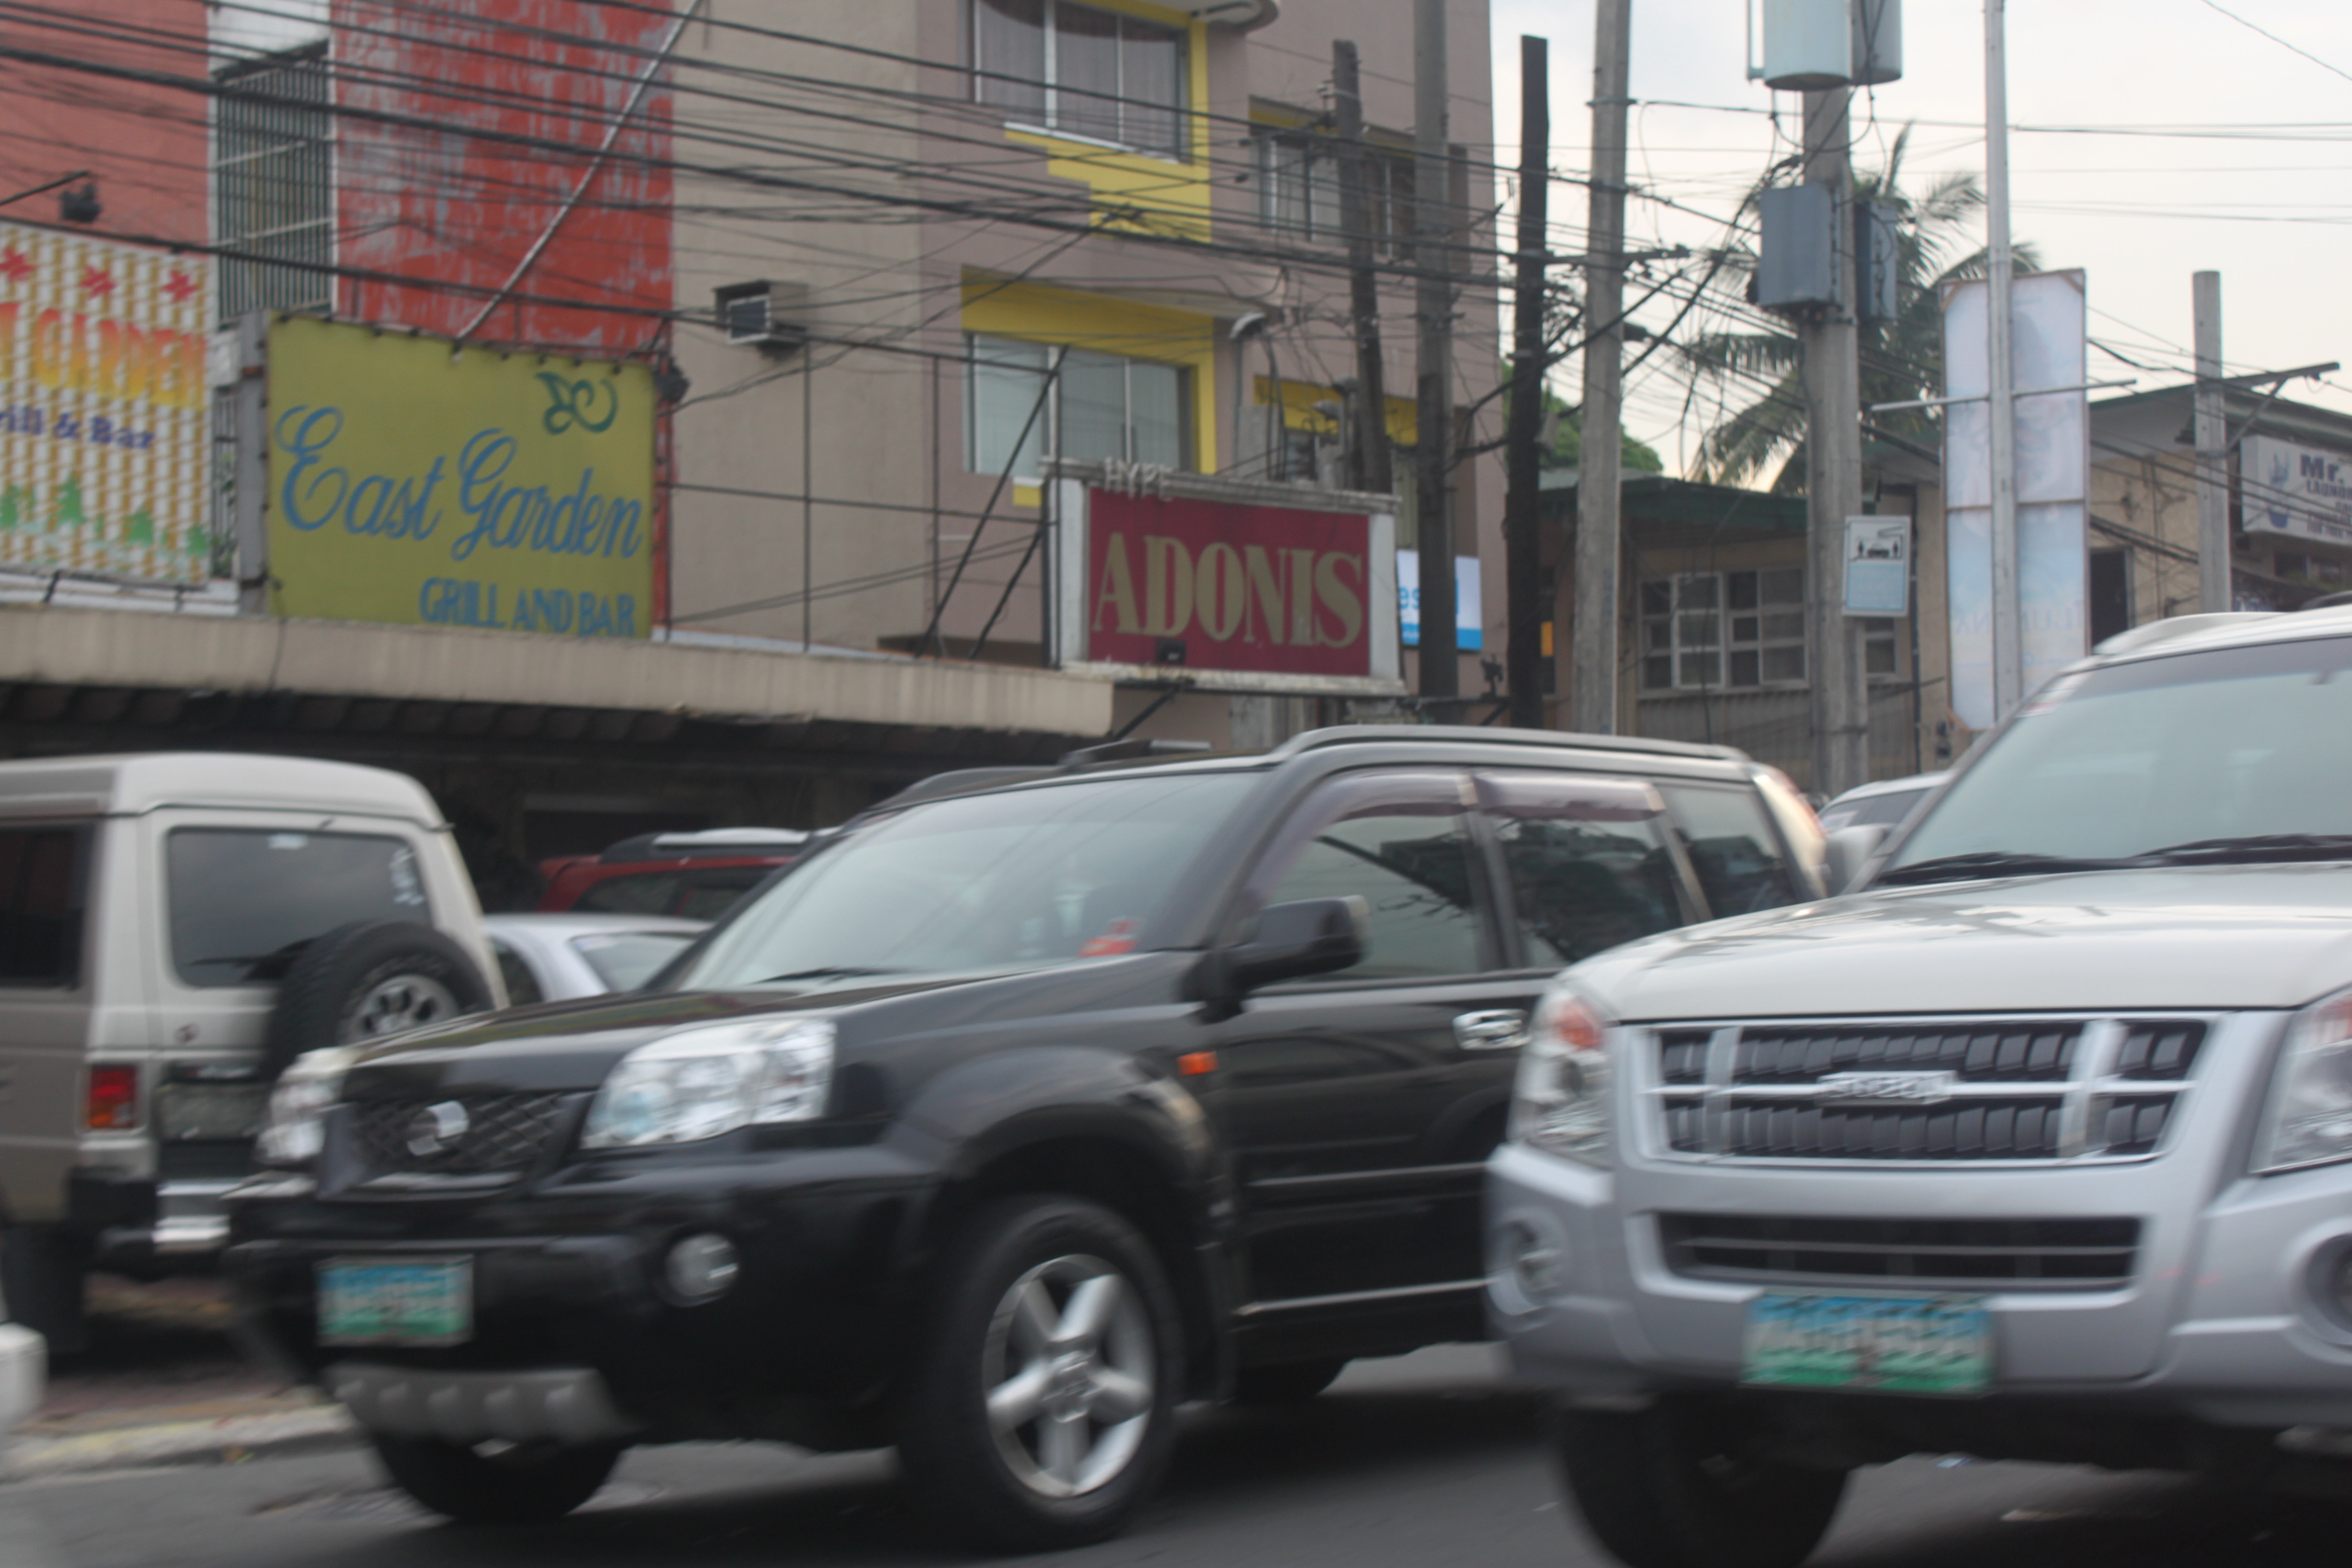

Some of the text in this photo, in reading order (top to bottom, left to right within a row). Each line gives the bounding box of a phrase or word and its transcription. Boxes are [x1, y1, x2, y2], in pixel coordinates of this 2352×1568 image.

[53, 413, 81, 441] &
[88, 417, 155, 450] Bar
[274, 405, 643, 561] East Garden
[419, 577, 636, 637] GRILL AND BAR
[1092, 532, 1363, 649] ADONIS
